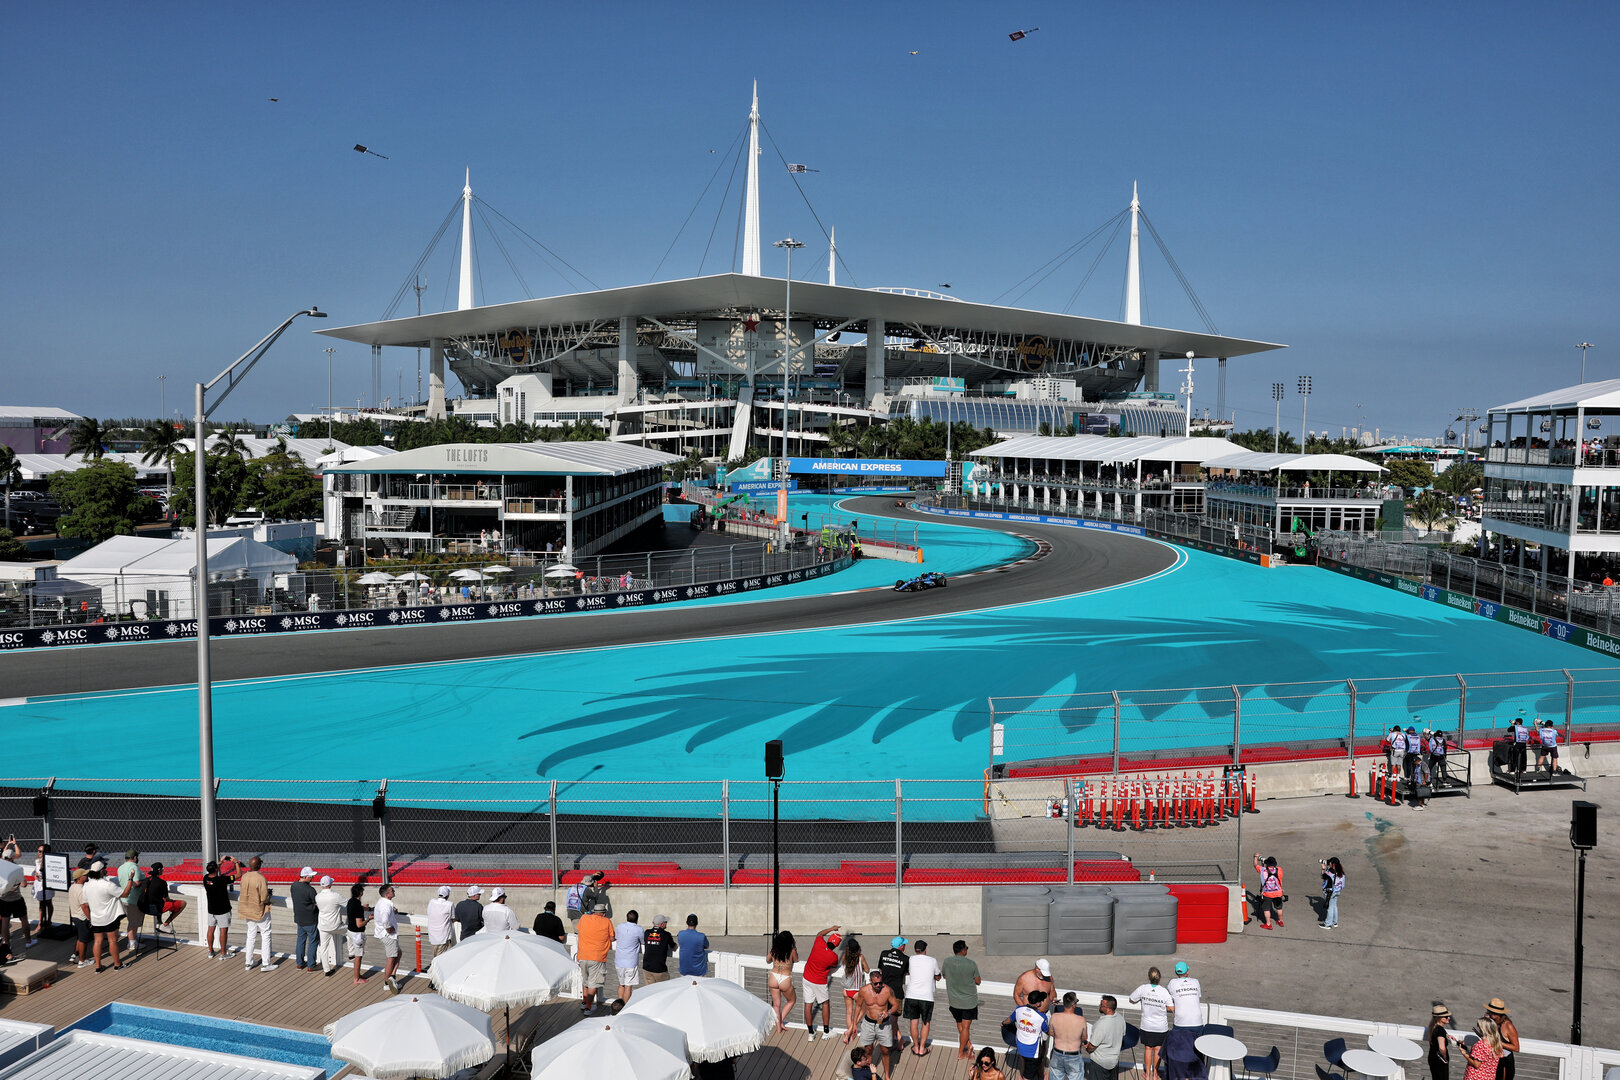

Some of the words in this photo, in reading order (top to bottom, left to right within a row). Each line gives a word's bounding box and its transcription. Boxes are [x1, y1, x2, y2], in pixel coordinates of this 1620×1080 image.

[446, 449, 461, 461] THE
[463, 449, 488, 462] LOFTS
[755, 457, 770, 476] 4
[812, 462, 858, 471] AMERICAN
[861, 463, 902, 472] EXPRESS
[772, 575, 782, 583] MSC
[793, 572, 801, 580] MSC
[723, 582, 736, 590] MSC
[749, 578, 761, 586] MSC
[1398, 579, 1418, 594] Heineken
[662, 590, 678, 598] MSC
[694, 586, 708, 594] MSC
[586, 597, 606, 606] MSC
[626, 593, 644, 602] MSC
[1447, 594, 1472, 610] Heineken
[500, 604, 522, 613] MSC
[545, 600, 566, 609] MSC
[401, 610, 425, 620] MSC
[452, 607, 475, 616] MSC
[294, 616, 320, 626] MSC
[349, 613, 374, 622] MSC
[1508, 610, 1539, 630] Heineken
[180, 622, 198, 632] MS
[239, 619, 266, 629] MSC
[57, 629, 87, 640] MSC
[121, 626, 150, 636] MSC
[0, 633, 23, 643] SC
[1587, 633, 1620, 655] Heineke
[882, 956, 903, 965] PETRONAS
